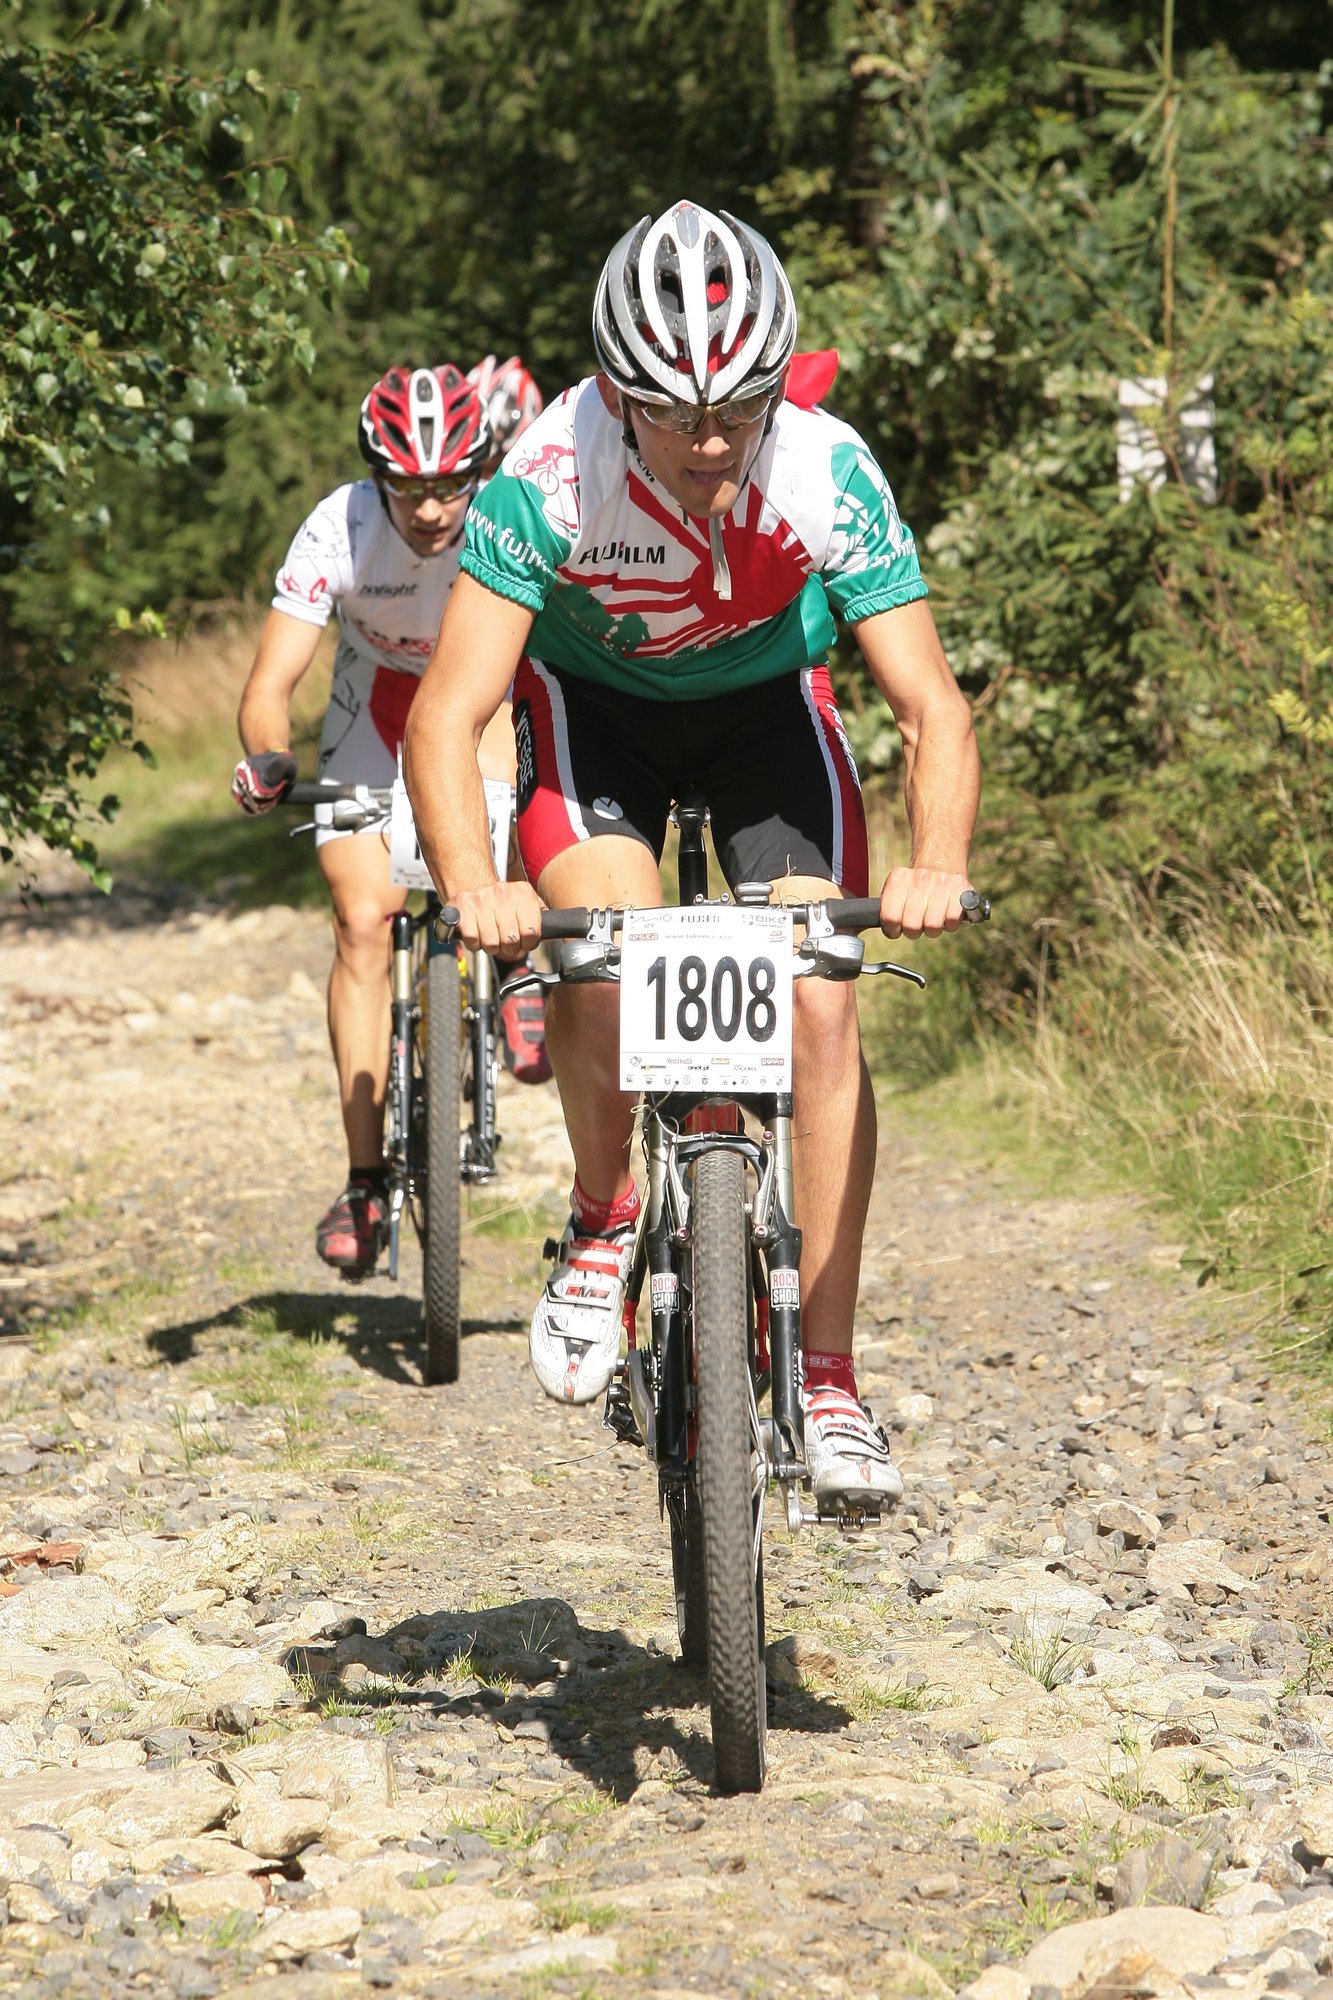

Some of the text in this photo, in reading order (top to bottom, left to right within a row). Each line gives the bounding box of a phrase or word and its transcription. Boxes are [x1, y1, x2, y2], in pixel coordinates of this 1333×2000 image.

[647, 955, 777, 1042] 1808
[652, 1279, 678, 1293] ROCK
[774, 1272, 798, 1287] ROCK
[773, 1288, 798, 1304] SHOX
